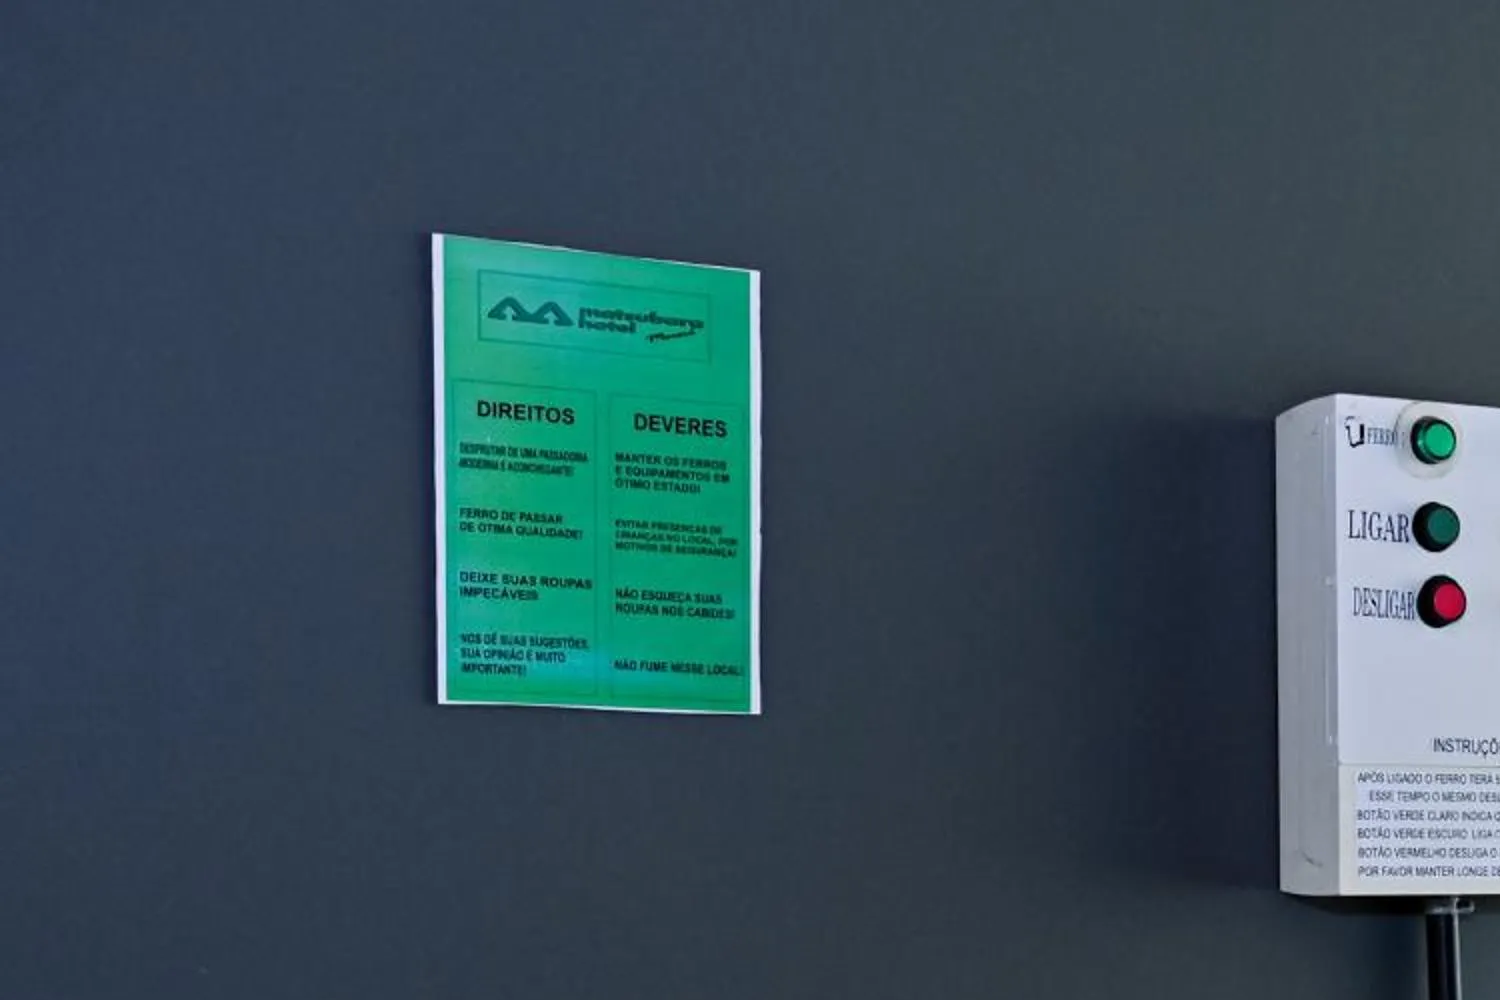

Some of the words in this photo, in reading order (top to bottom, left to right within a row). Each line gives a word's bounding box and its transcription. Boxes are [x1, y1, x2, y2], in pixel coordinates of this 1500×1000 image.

[578, 319, 637, 333] hotel
[477, 400, 575, 425] DIREITOS
[634, 412, 728, 437] DEVERES
[507, 446, 518, 457] DE
[520, 447, 537, 459] UMA
[615, 451, 662, 465] MANTER
[663, 456, 680, 467] OS
[682, 458, 727, 470] FERROS
[625, 466, 711, 482] EQUIPAMENTOS
[713, 473, 731, 483] EM
[459, 507, 499, 520] FERRO
[501, 511, 516, 522] DE
[519, 511, 564, 524] PASSAR
[459, 522, 476, 533] DE
[1348, 510, 1410, 543] LIGAR
[459, 571, 498, 584] DEIXE
[501, 573, 537, 587] SUAS
[539, 576, 593, 589] ROUPAS
[615, 587, 639, 600] NÃO
[694, 592, 723, 605] SUAS
[615, 603, 659, 616] ROUPAS
[661, 606, 685, 617] NOS
[1352, 587, 1416, 621] DESLIGAR
[499, 634, 527, 646] SUAS
[461, 648, 481, 659] SUA
[535, 651, 566, 663] MUITO
[613, 659, 637, 671] NÃO
[639, 660, 669, 672] FUME
[1358, 771, 1385, 784] APÓS
[1387, 773, 1423, 785] LIGADO
[1424, 774, 1433, 785] O
[1435, 774, 1467, 785] FERRO
[1369, 789, 1395, 802] ESSE
[1397, 790, 1430, 803] TEMPO
[1431, 791, 1440, 802] O
[1442, 791, 1477, 803] MESMO
[1357, 808, 1391, 821] BOTÃO
[1393, 809, 1425, 821] VERDE
[1427, 810, 1459, 821] CLARO
[1462, 810, 1493, 821] INDICA
[1357, 826, 1391, 839] BOTÃO
[1393, 828, 1425, 839] VERDE
[1427, 828, 1469, 839] ESCURO
[1471, 829, 1493, 840] LIGA
[1358, 845, 1392, 859] BOTÃO
[1393, 847, 1447, 859] VERMELHO
[1449, 847, 1488, 859] DESLIGA
[1489, 847, 1497, 858] O
[1358, 865, 1379, 877] POR
[1381, 865, 1413, 877] FAVOR
[1415, 865, 1455, 877] MANTER
[1457, 866, 1488, 877] LONGE
